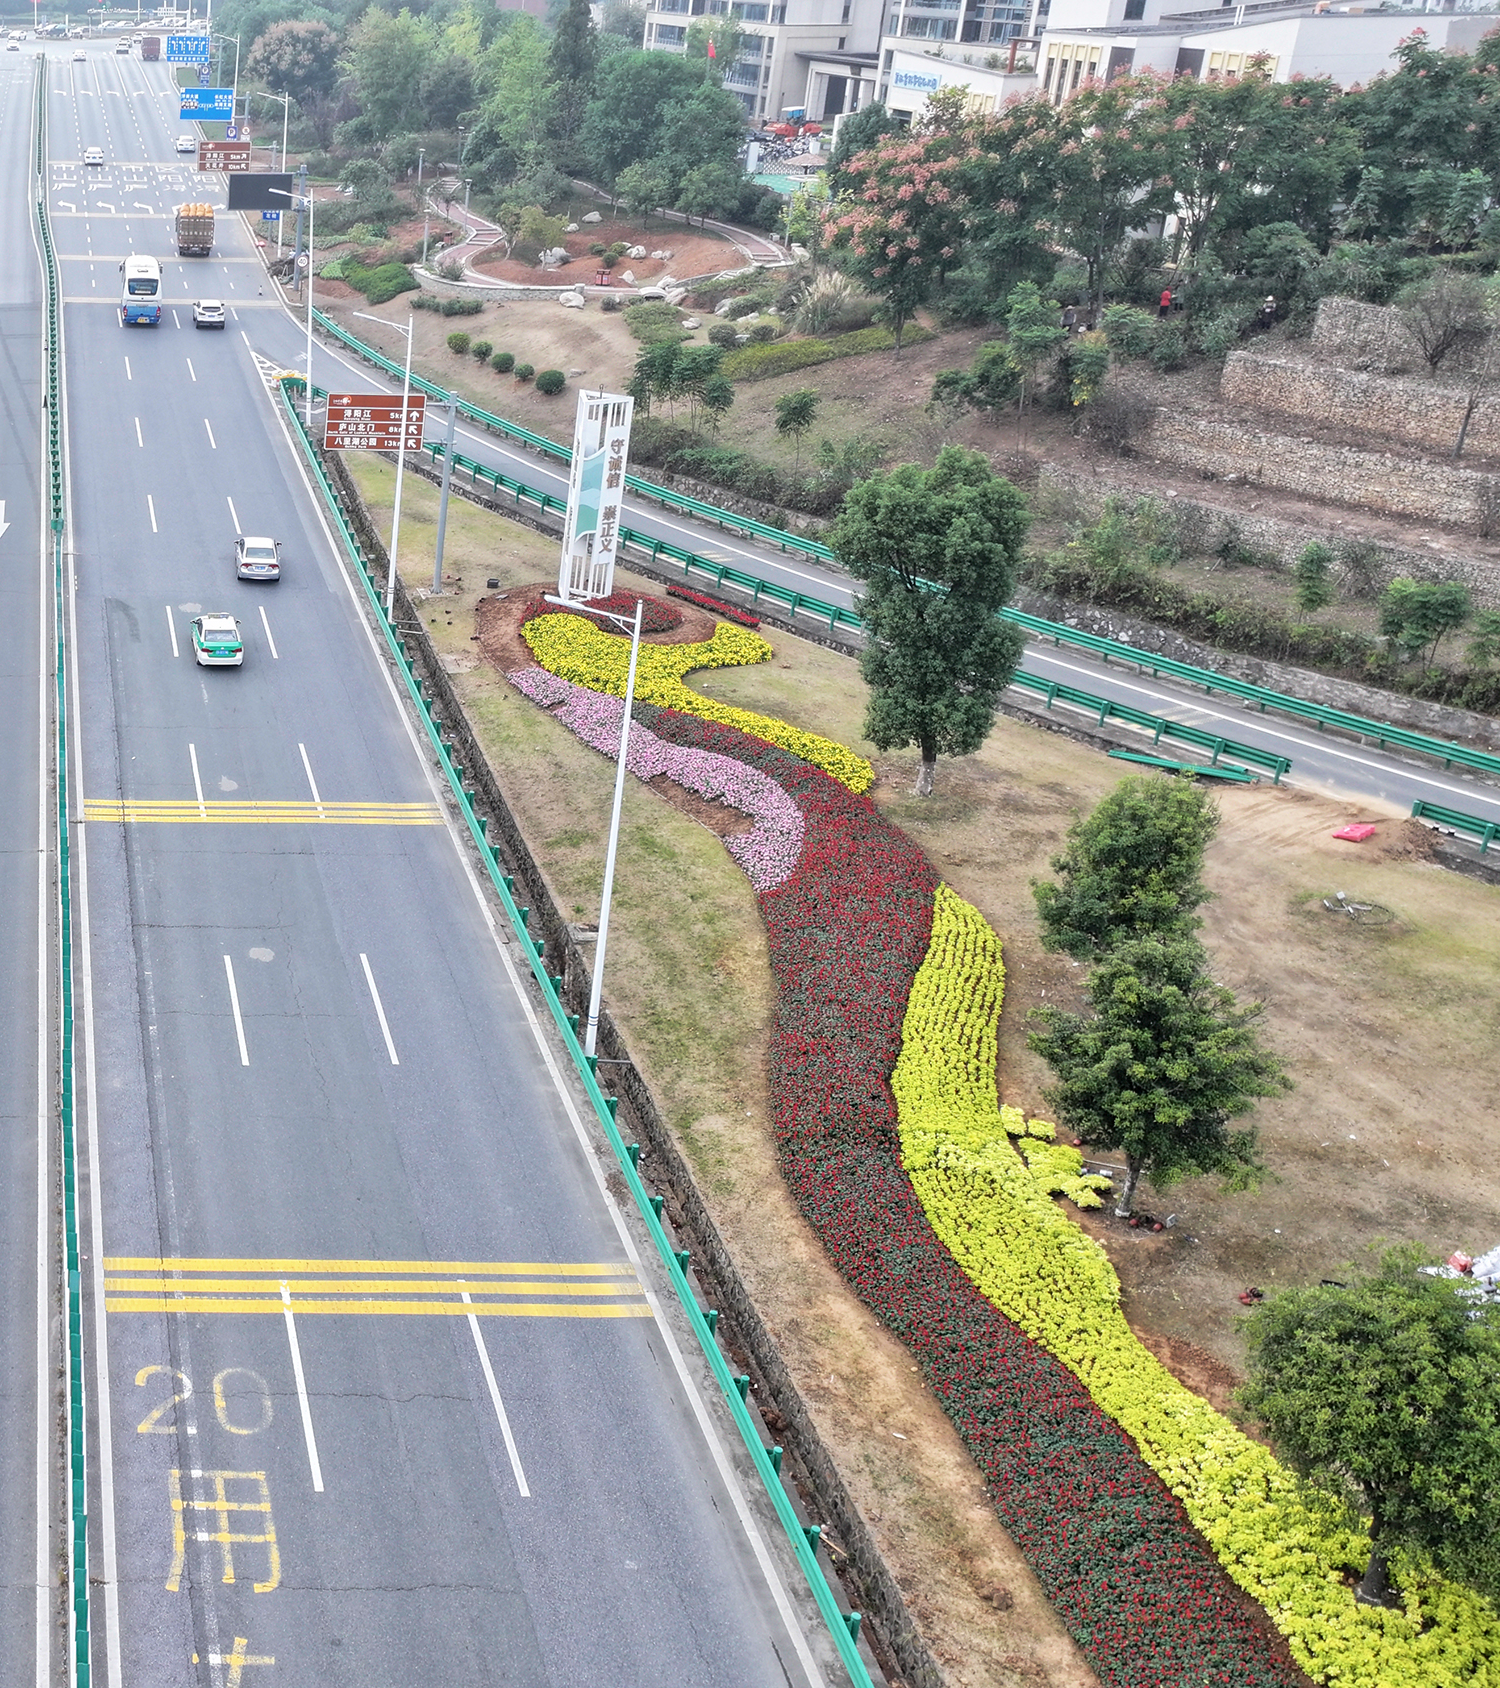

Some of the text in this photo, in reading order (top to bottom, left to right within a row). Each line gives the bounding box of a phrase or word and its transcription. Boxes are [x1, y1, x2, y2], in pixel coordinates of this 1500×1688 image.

[338, 423, 376, 432] 庐山北门
[343, 409, 372, 418] 浔阳江
[334, 437, 378, 446] 八里湖公园
[605, 438, 625, 489] 守诚信
[599, 505, 618, 554] 崇正义
[135, 1365, 273, 1435] 20
[165, 1469, 281, 1593] 用
